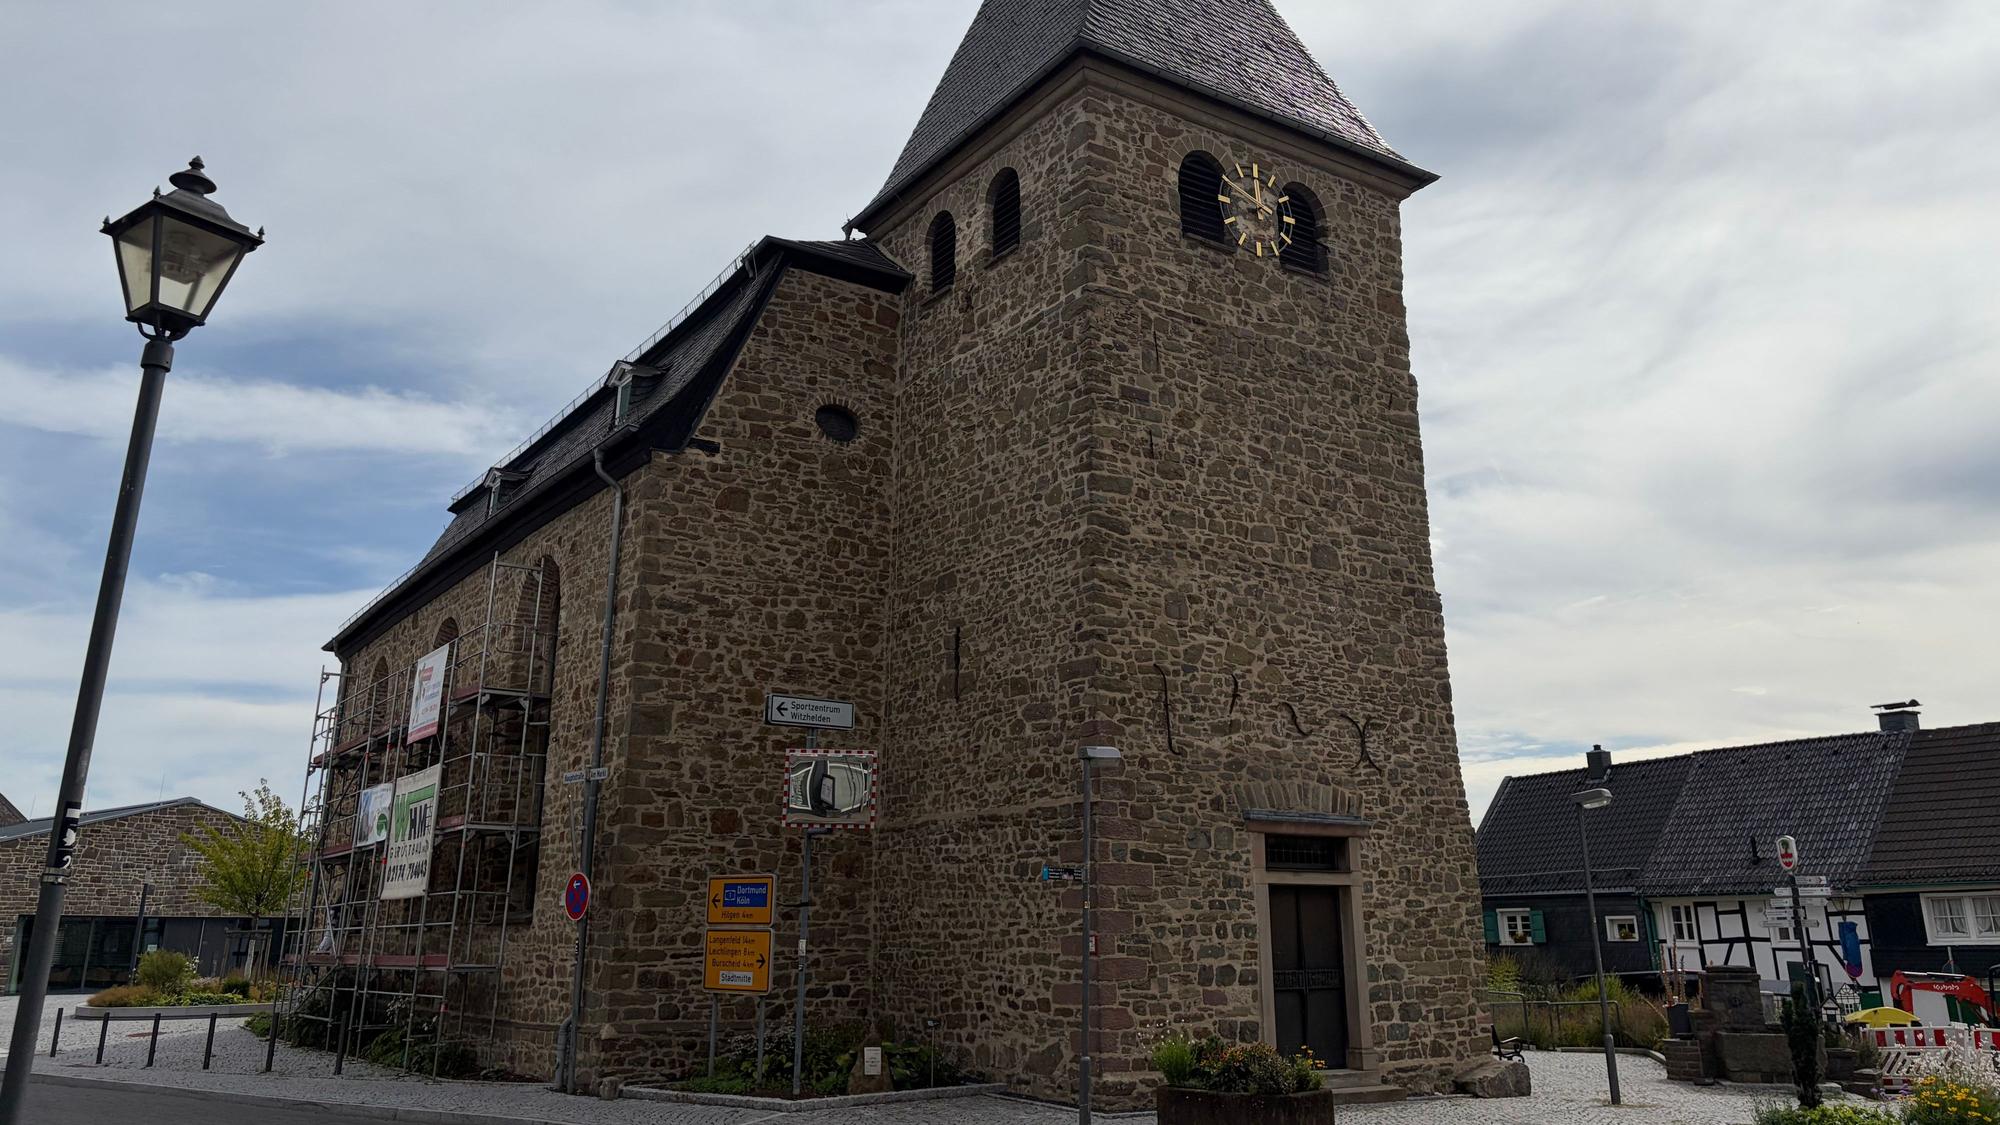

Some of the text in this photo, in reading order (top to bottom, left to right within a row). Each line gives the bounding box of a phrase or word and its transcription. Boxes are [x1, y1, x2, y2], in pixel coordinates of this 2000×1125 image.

[790, 701, 841, 714] Sportzentrum
[790, 711, 831, 723] Witzhelden
[737, 885, 767, 895] Dortmund
[736, 896, 750, 905] Köln
